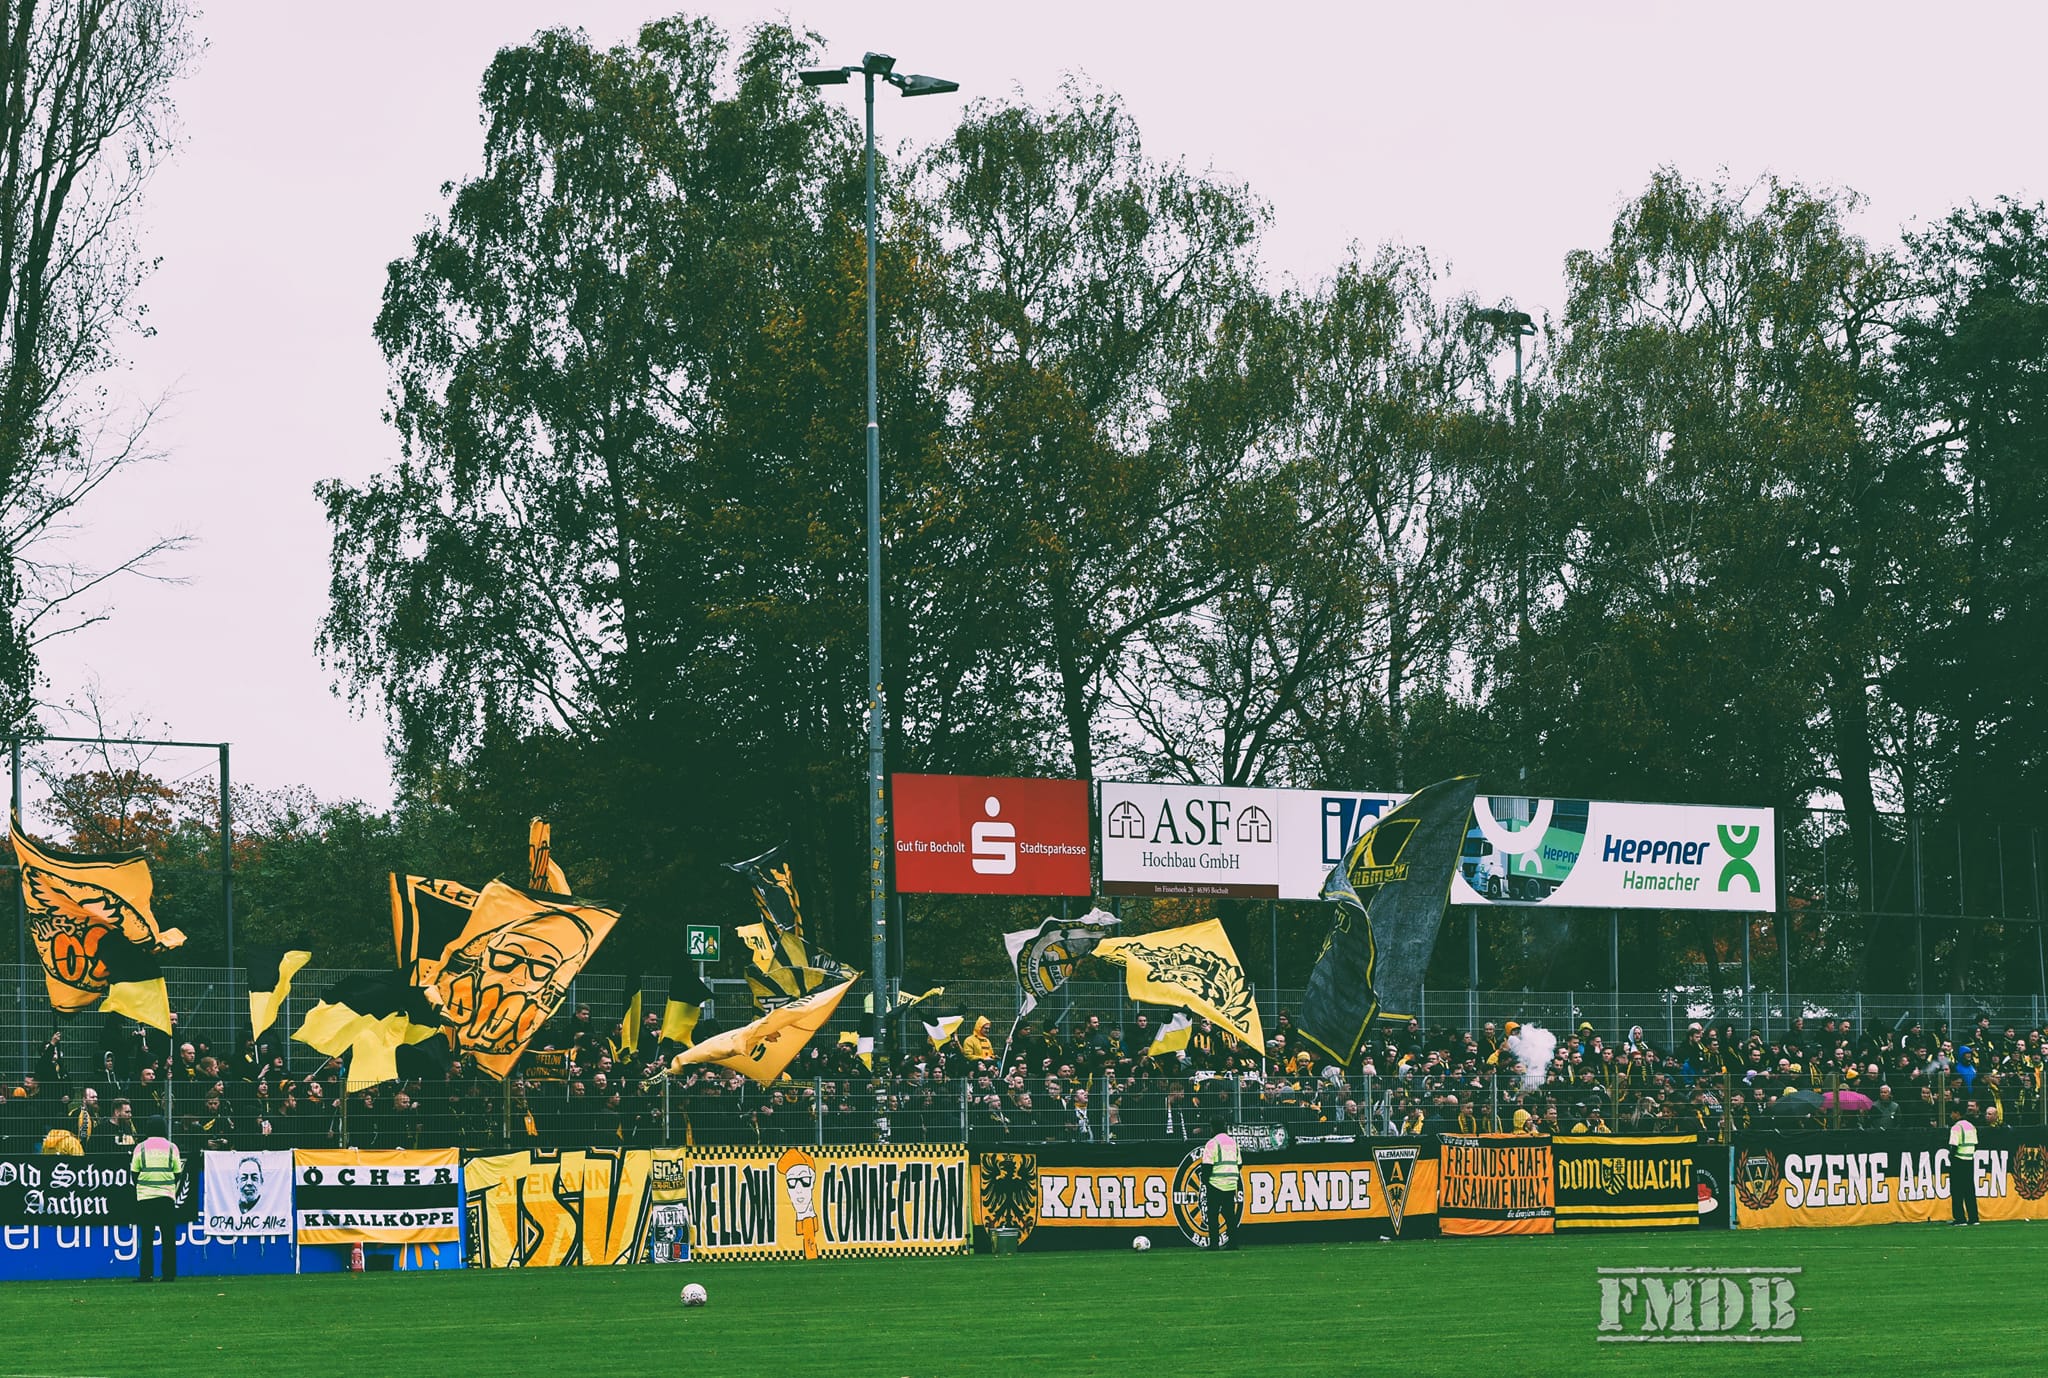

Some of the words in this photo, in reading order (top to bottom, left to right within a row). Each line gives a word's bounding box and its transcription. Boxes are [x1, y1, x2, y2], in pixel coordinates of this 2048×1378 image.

[1150, 798, 1231, 846] ASF
[897, 840, 912, 852] Gut
[915, 840, 928, 852] für
[930, 841, 965, 853] Bocholt
[1020, 843, 1086, 856] Stadtsparkasse
[1143, 851, 1196, 868] Hochbau
[1200, 853, 1240, 869] GmbH
[1623, 870, 1700, 891] Hamacher
[1378, 1151, 1415, 1159] ALEMANNIA
[1446, 1146, 1548, 1178] FREUNDSCHAFT
[0, 1161, 41, 1187] Old
[303, 1166, 452, 1185] ÖCHER
[1627, 1158, 1693, 1190] WACHT
[1784, 1152, 1889, 1208] SZENE
[1898, 1149, 2009, 1199] AACEN
[24, 1190, 109, 1218] Aachen
[688, 1164, 775, 1247] YELLOW
[823, 1160, 964, 1246] CONNECTION
[1040, 1174, 1167, 1219] KARLS
[1250, 1170, 1370, 1215] BANDE
[1443, 1176, 1549, 1208] ZUSAMMENHALT
[304, 1212, 453, 1227] KNALLKÖPPE
[464, 1149, 651, 1268] TSV
[658, 1210, 684, 1226] NEIN
[210, 1216, 234, 1230] OPA
[235, 1216, 260, 1231] JAC
[655, 1242, 669, 1258] ZU
